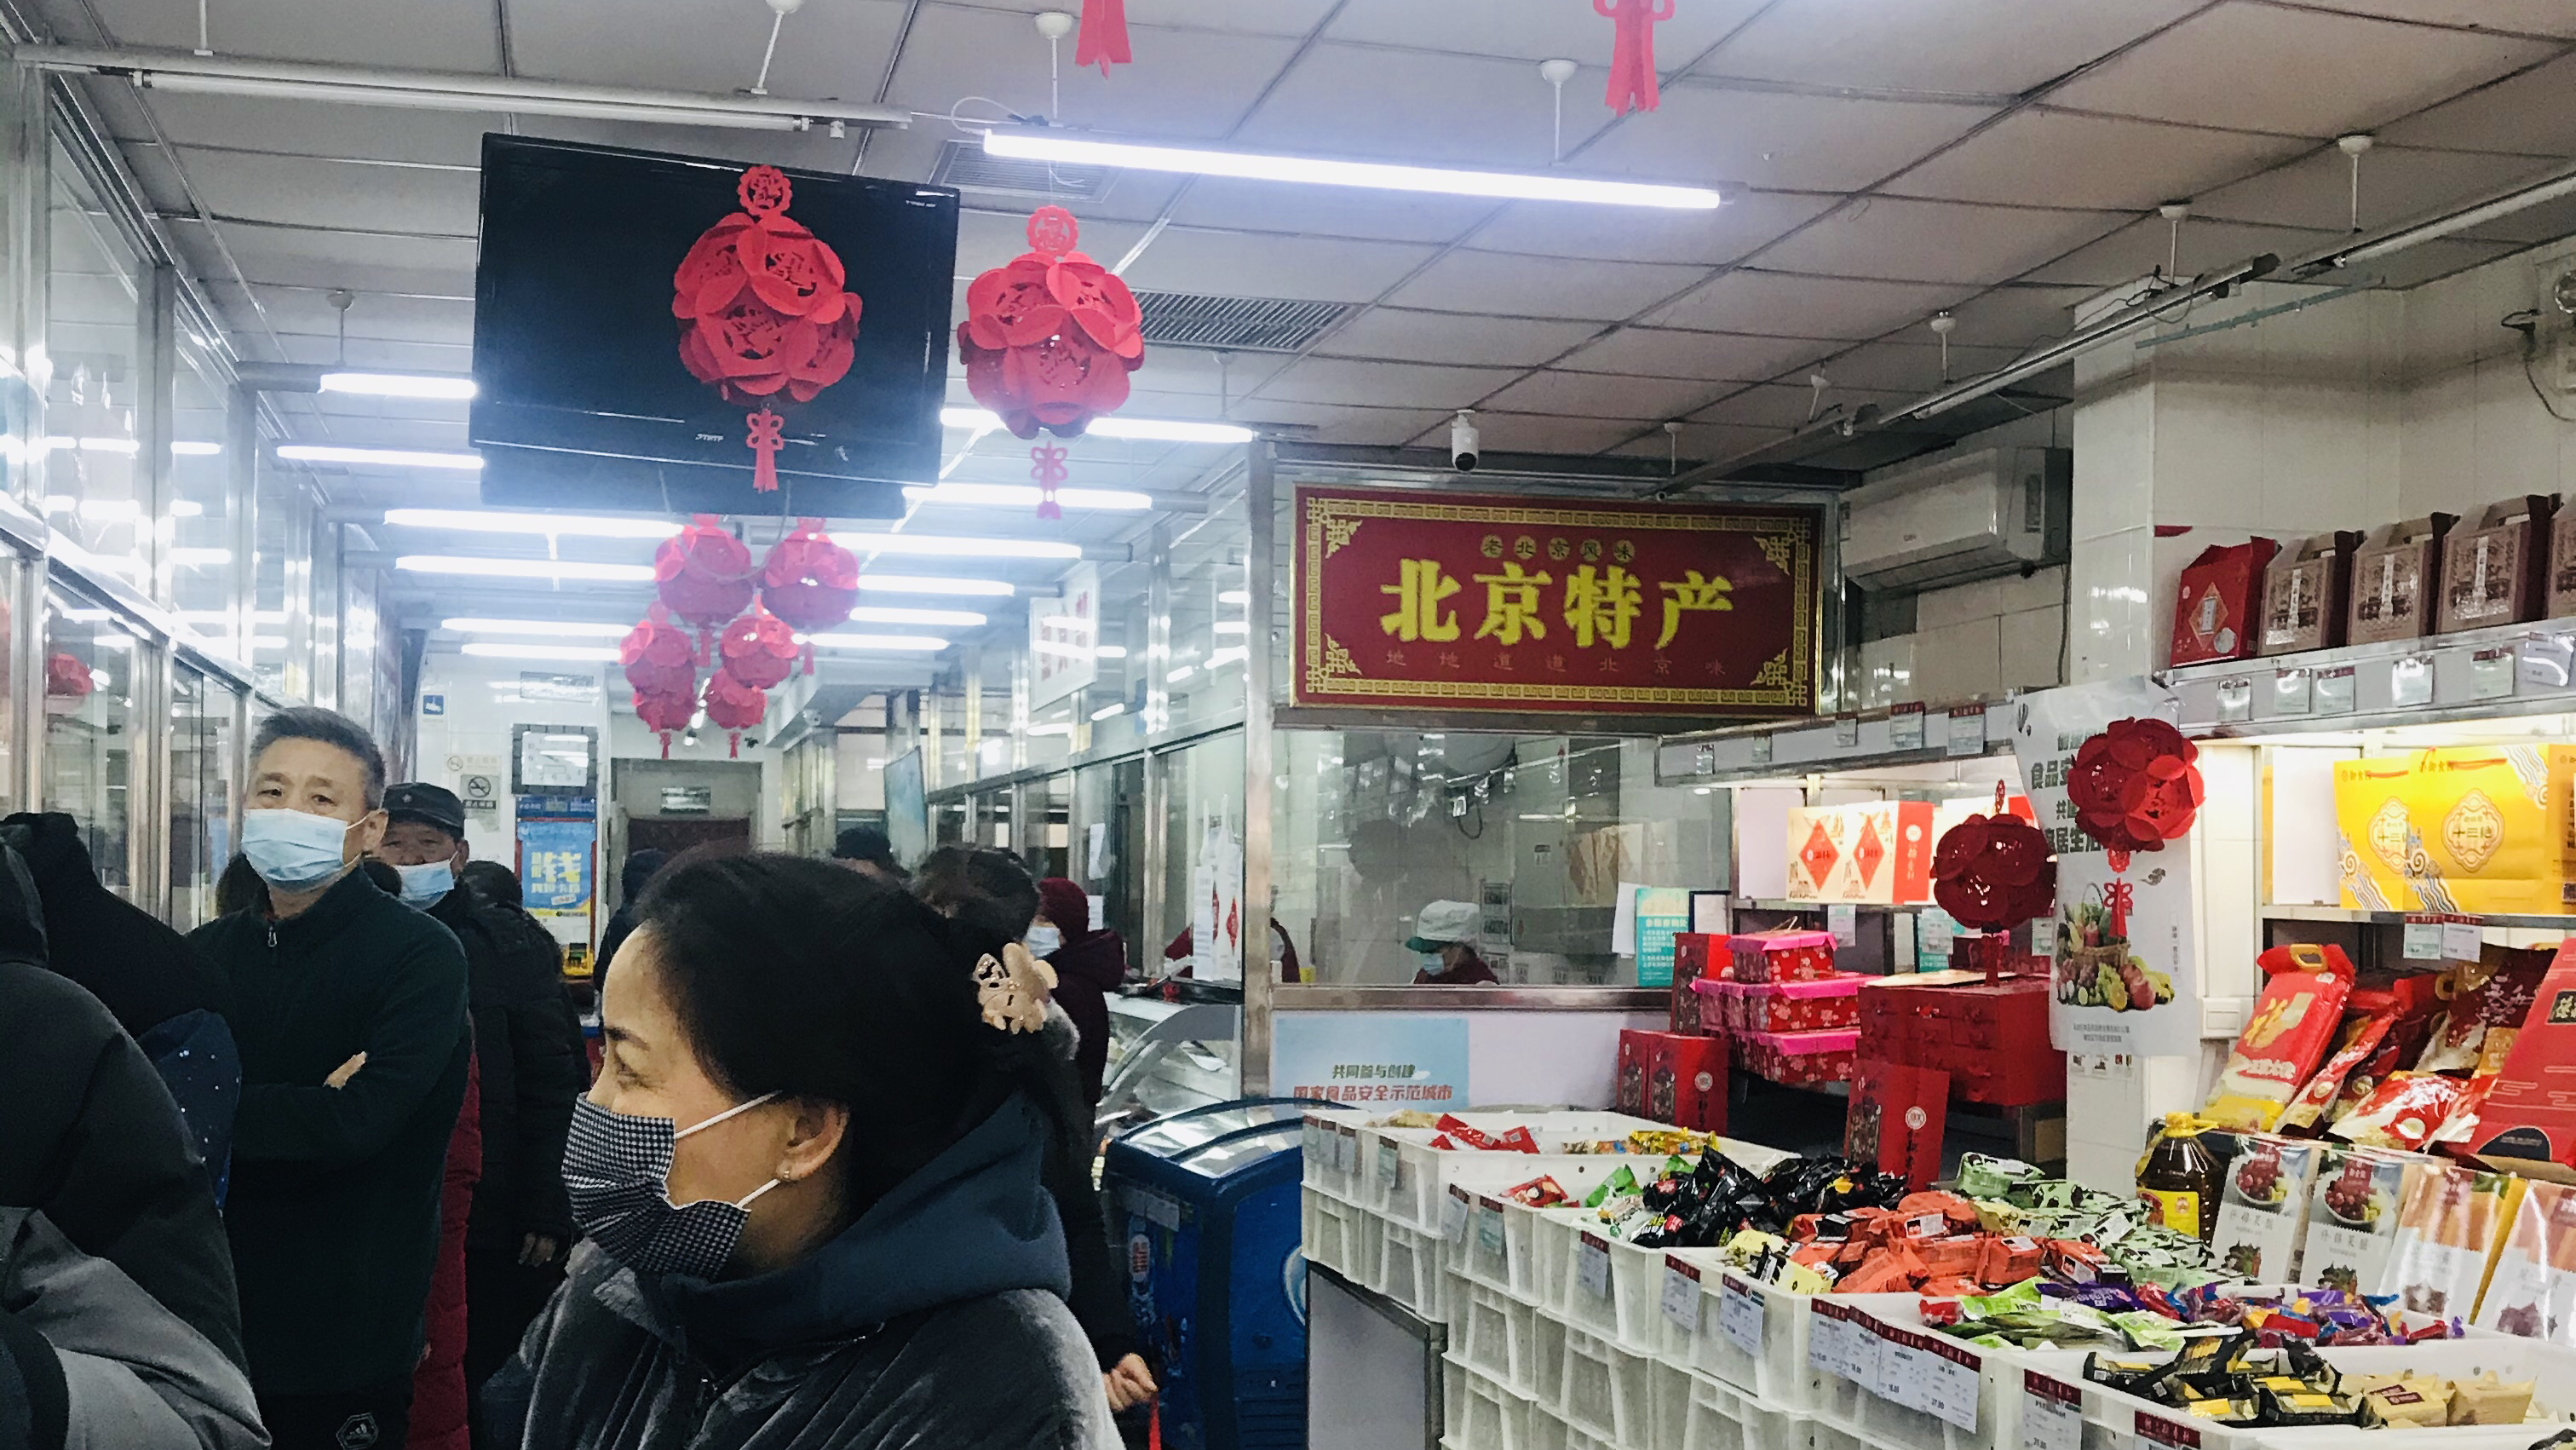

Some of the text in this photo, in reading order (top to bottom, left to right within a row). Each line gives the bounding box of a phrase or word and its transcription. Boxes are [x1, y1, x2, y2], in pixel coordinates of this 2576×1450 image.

[1380, 558, 1734, 650] 北京特产
[1386, 648, 1727, 676] 地地道道北京味
[1332, 1064, 1416, 1079] 共同参与创建
[1293, 1085, 1453, 1102] 国家食品安全示范城市
